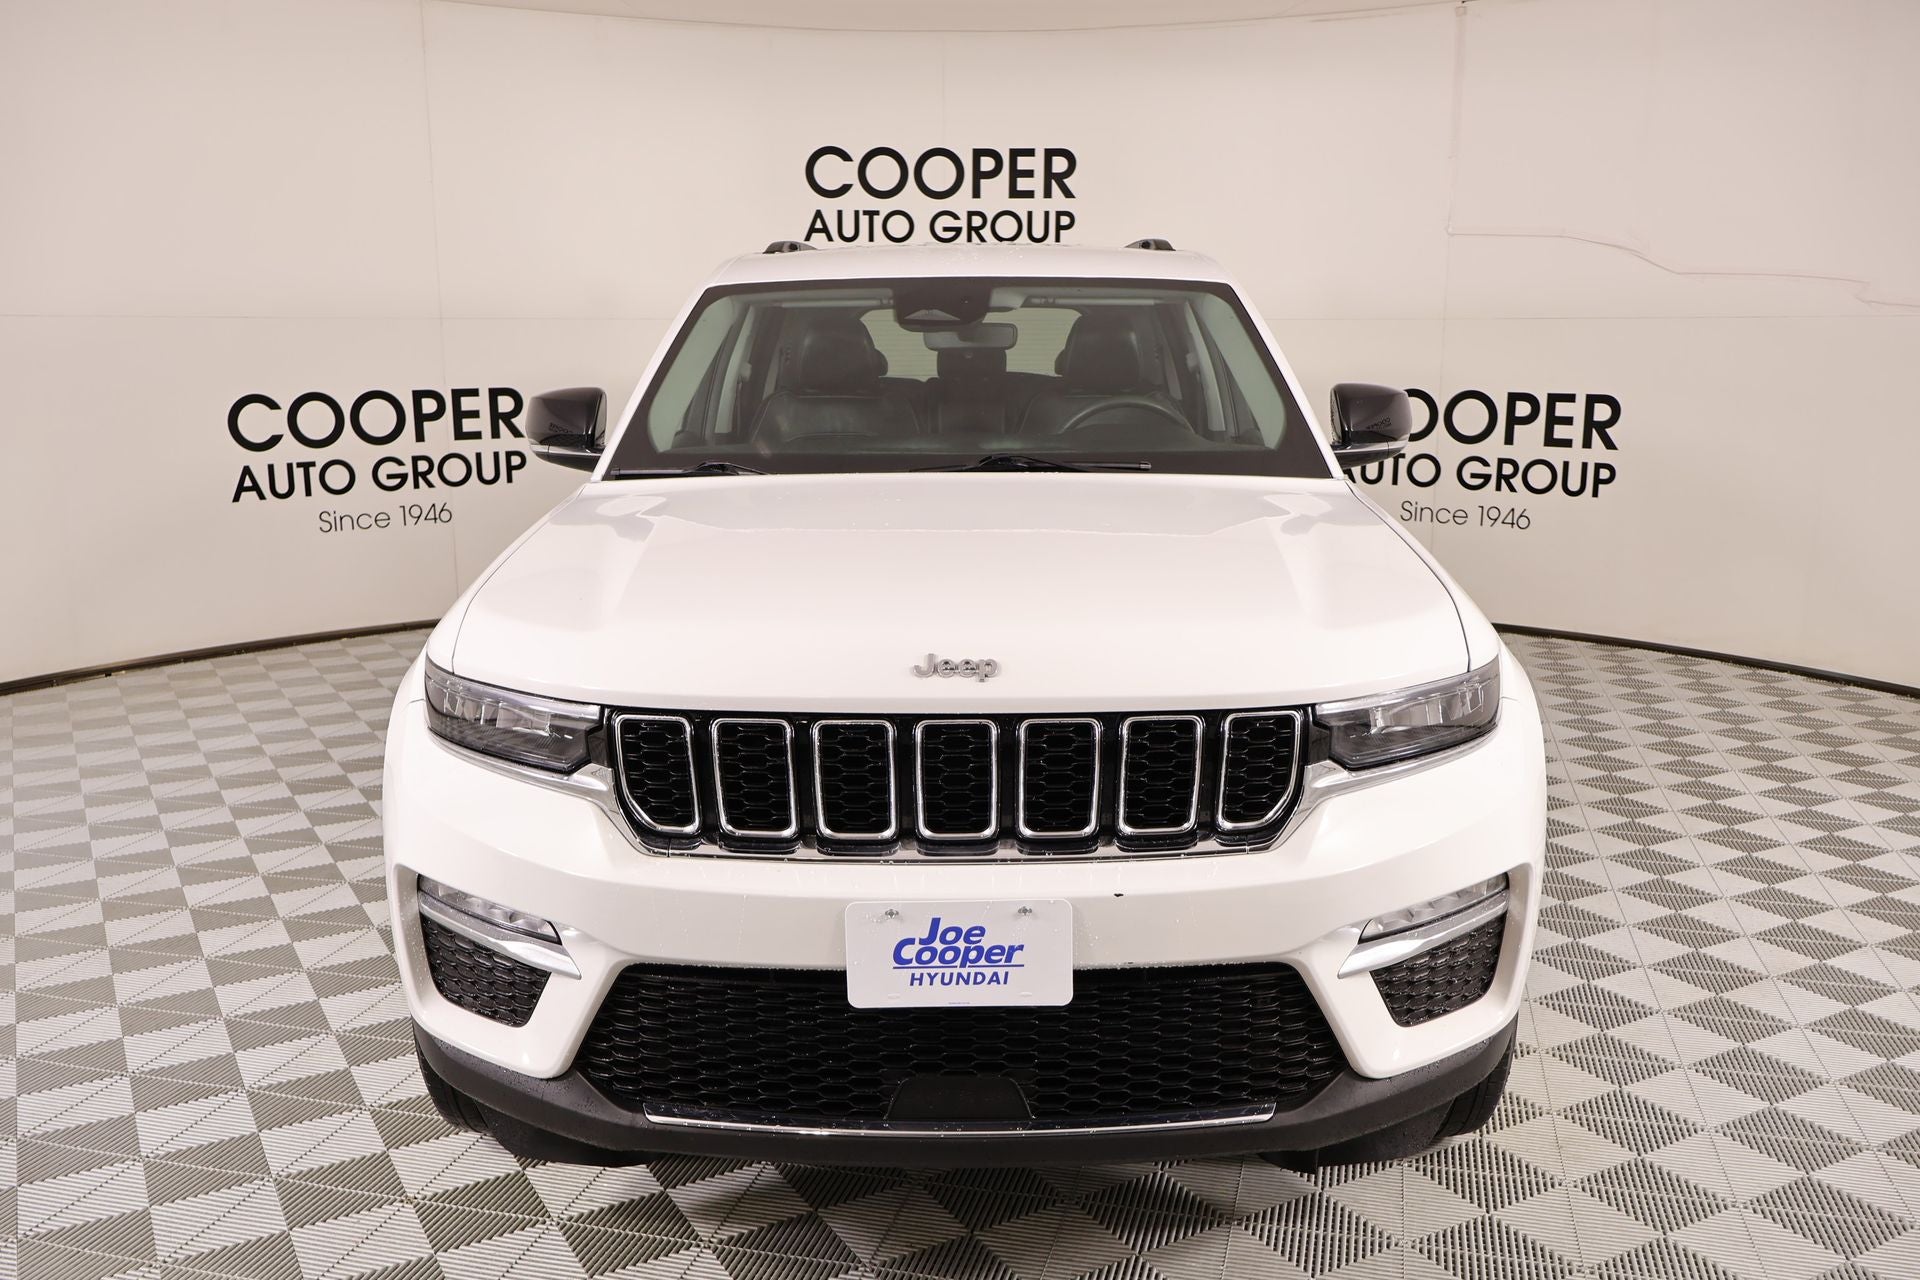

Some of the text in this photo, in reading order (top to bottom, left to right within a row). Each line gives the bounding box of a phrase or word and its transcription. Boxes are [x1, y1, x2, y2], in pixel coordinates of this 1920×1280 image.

[805, 146, 1077, 200] COOPER
[804, 209, 1076, 243] AUTO GROUP
[227, 387, 525, 452] COOPER
[1403, 388, 1621, 450] OOPER
[231, 450, 527, 503] AUTO GROUP
[1343, 453, 1617, 498] UTO GROUP
[318, 502, 453, 534] Since 1946
[1399, 500, 1532, 530] Since 1946
[913, 653, 999, 682] Jeep
[919, 917, 986, 946] Joe
[892, 937, 1025, 969] Cooper
[909, 971, 1010, 986] HYUNDAI
